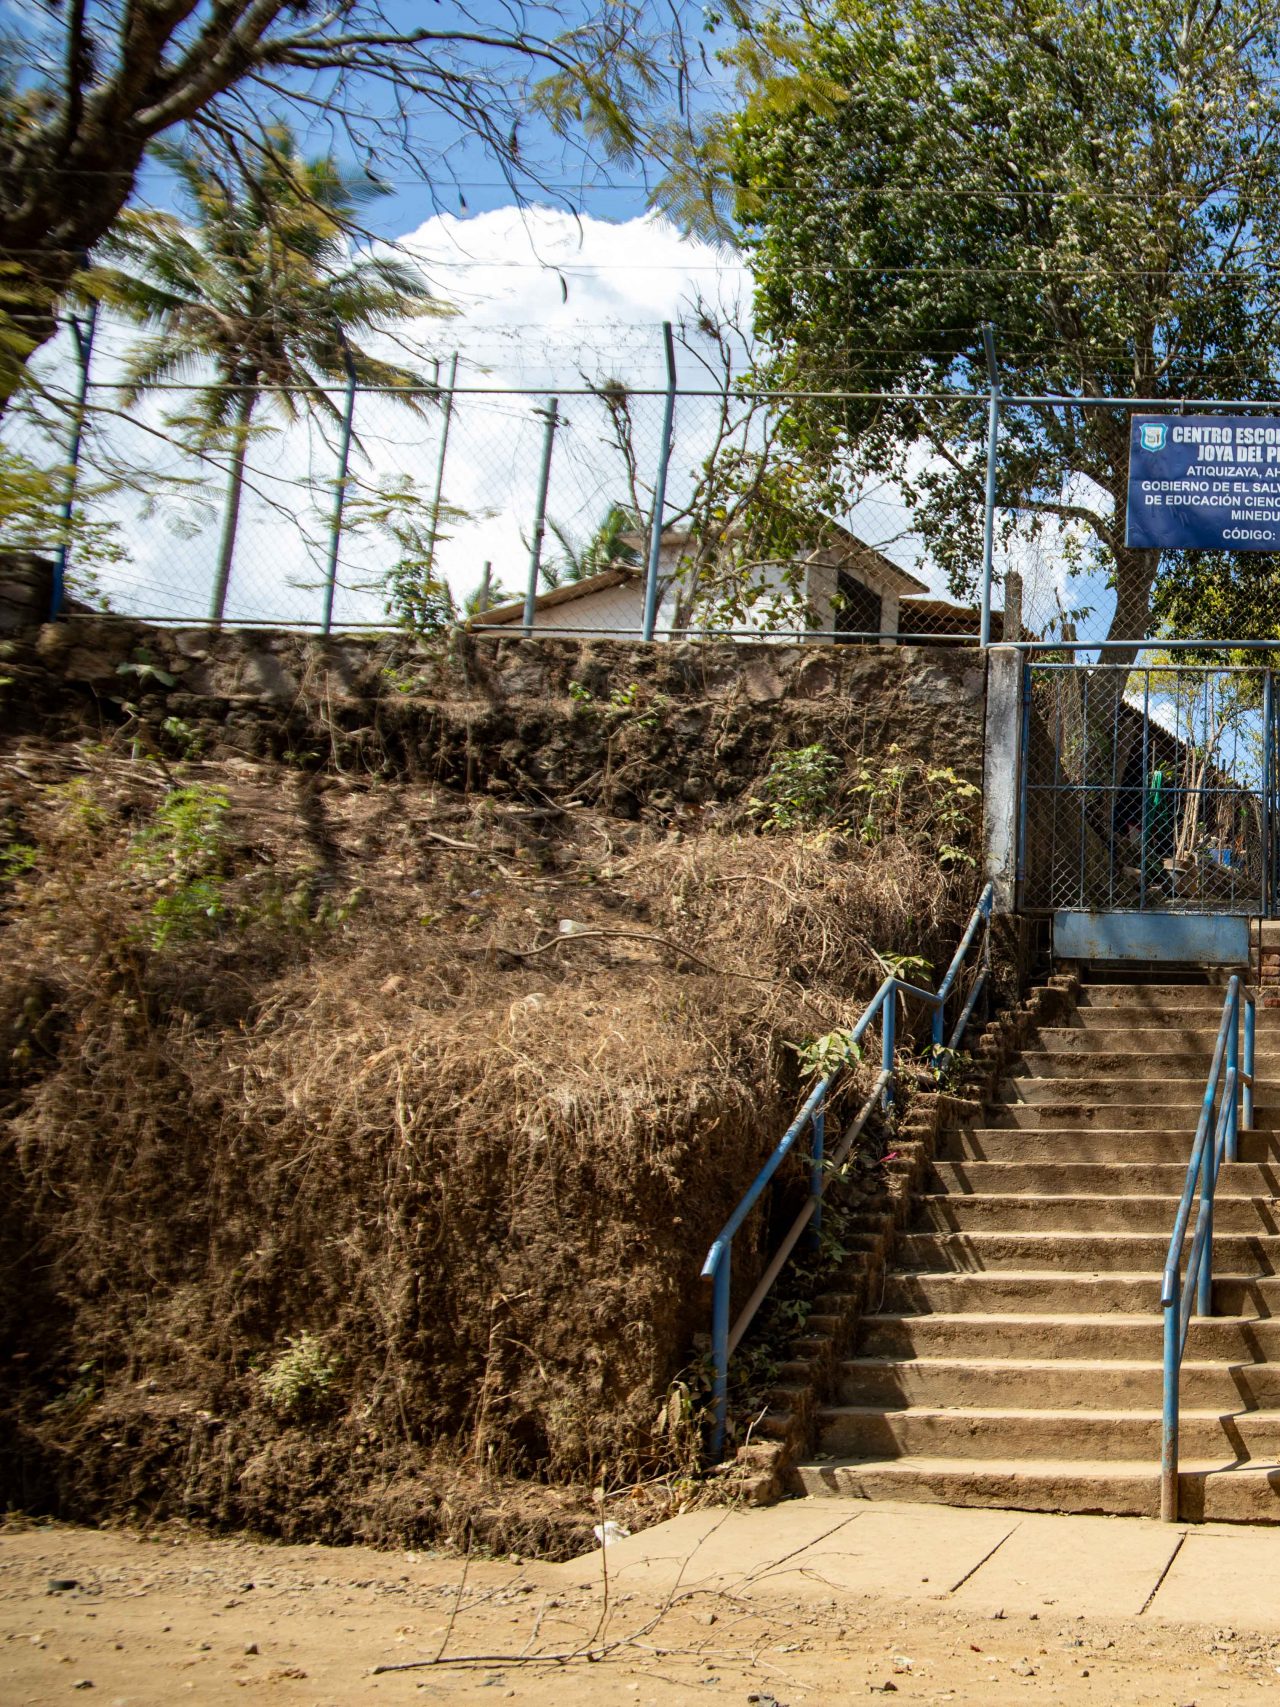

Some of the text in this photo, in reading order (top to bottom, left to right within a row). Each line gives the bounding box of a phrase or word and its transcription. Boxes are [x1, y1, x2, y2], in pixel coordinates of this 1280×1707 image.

[1172, 426, 1232, 444] CENTRO
[1197, 444, 1234, 461] JOYA
[1237, 446, 1263, 462] DEL
[1186, 465, 1262, 479] ATIQUIZAYA,
[1141, 481, 1209, 492] GOBIERNO
[1213, 482, 1230, 492] DE
[1233, 482, 1249, 493] EL
[1145, 494, 1162, 505] DE
[1165, 493, 1241, 507] EDUCACIÓN
[1222, 527, 1276, 541] CÓDIGO:
